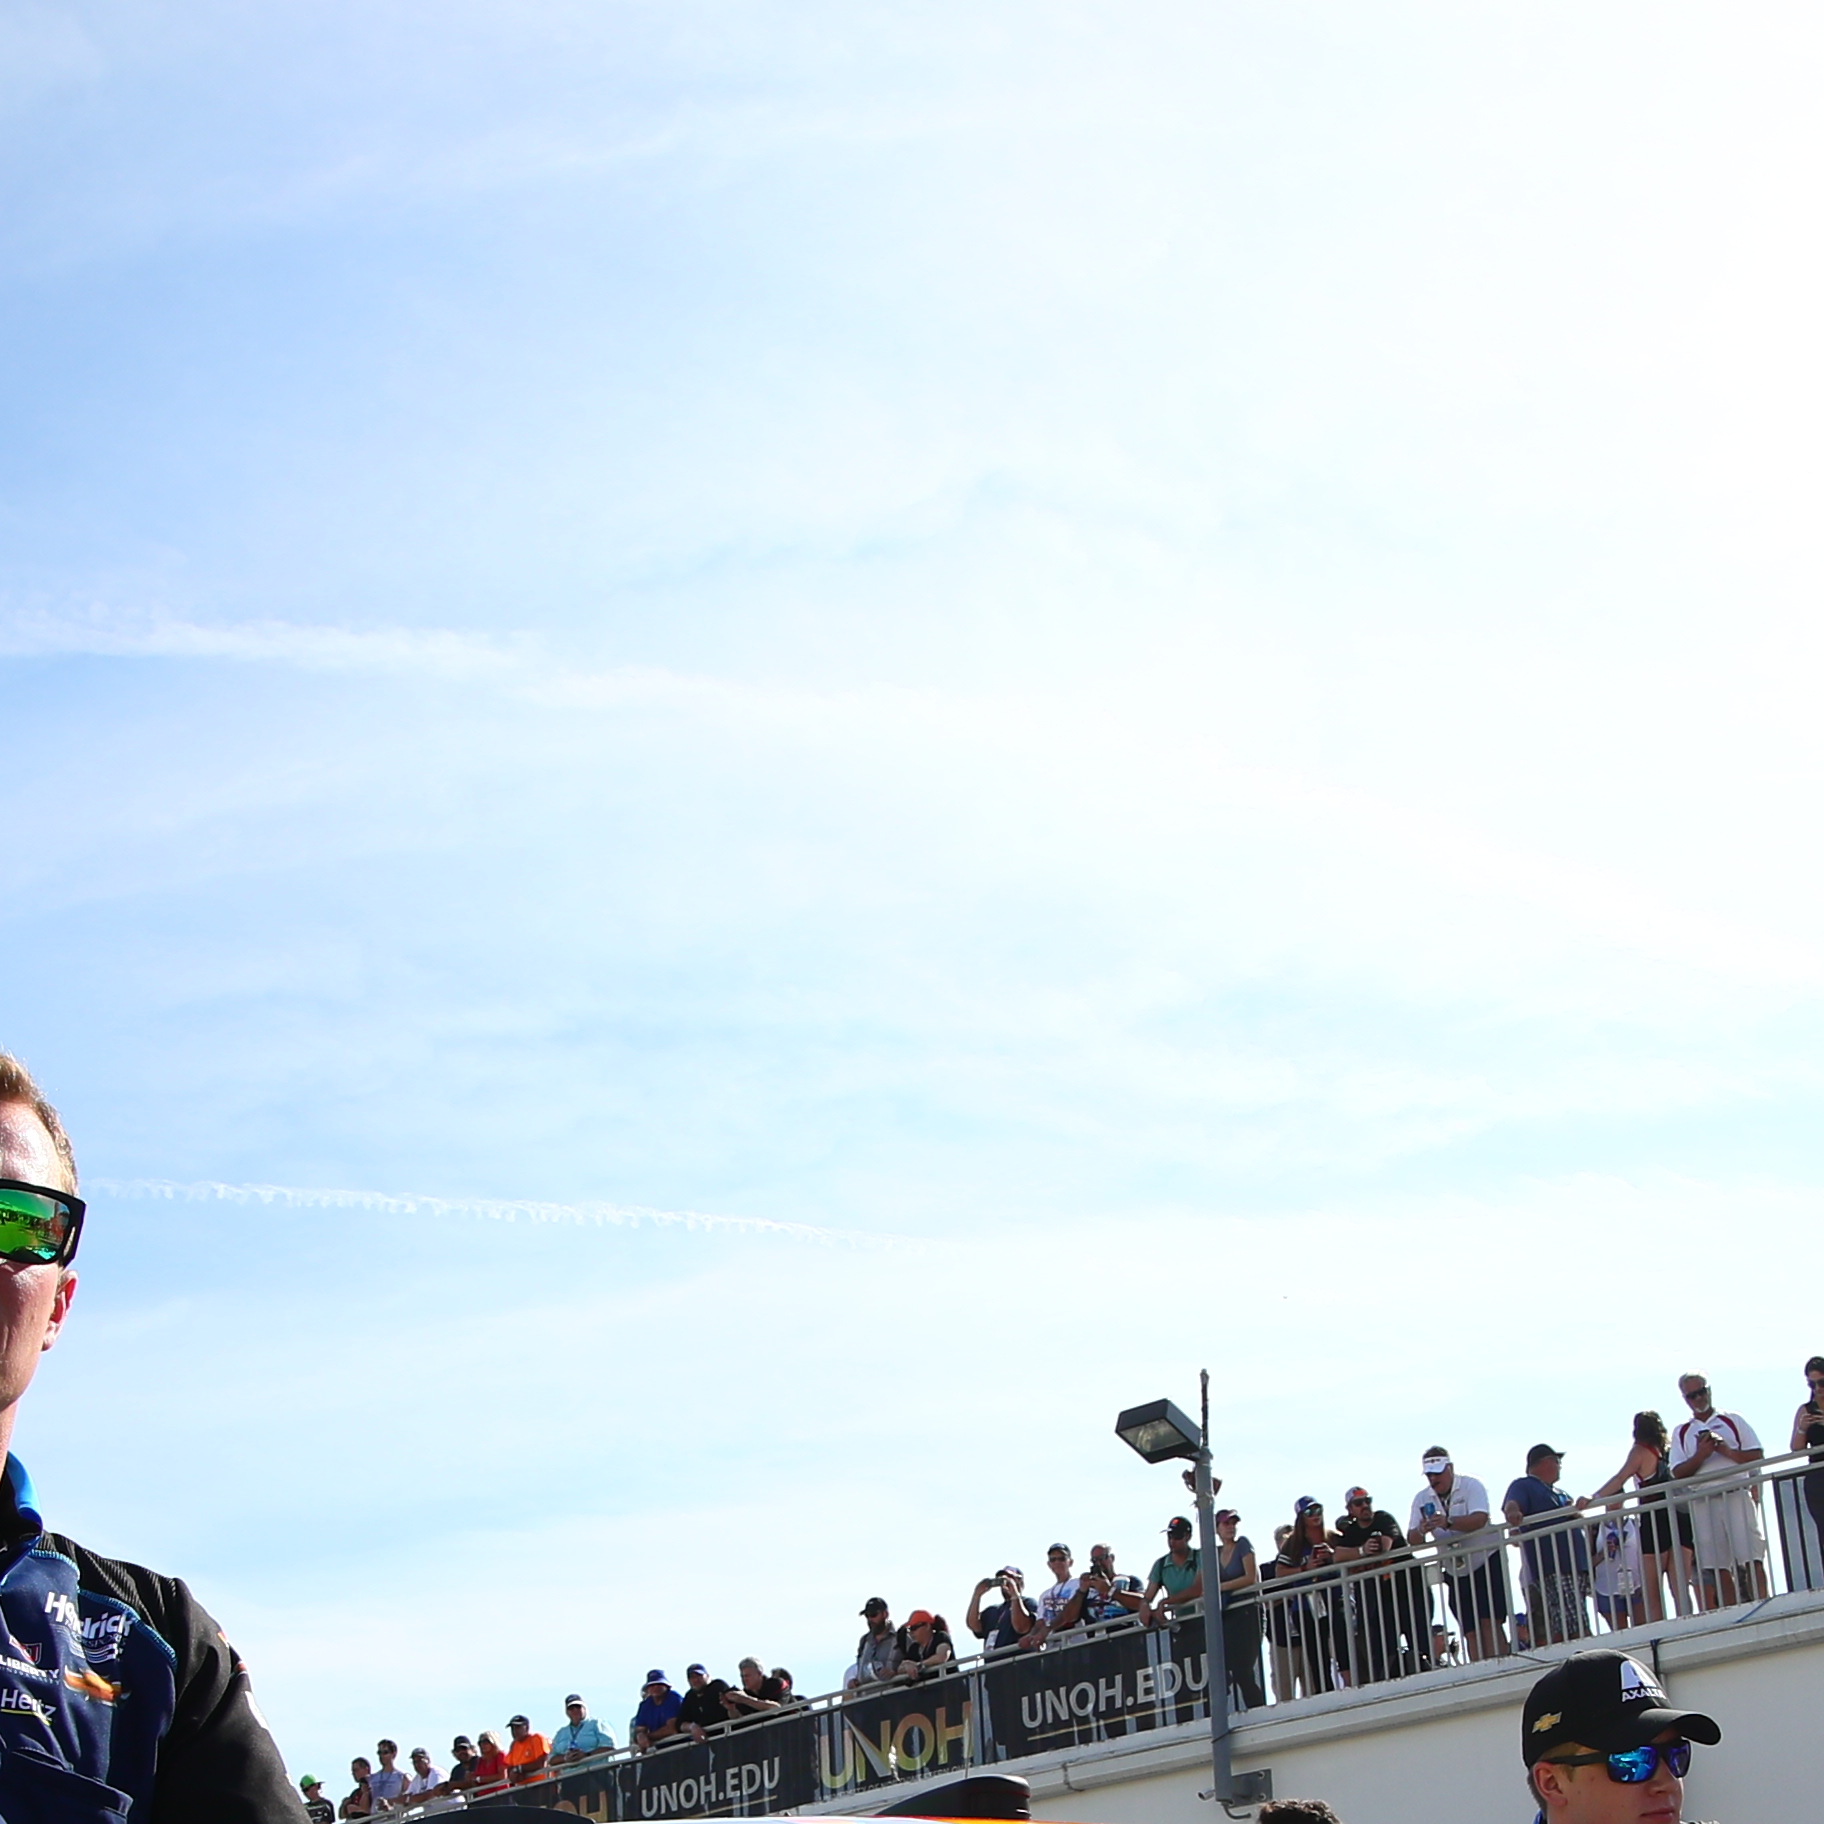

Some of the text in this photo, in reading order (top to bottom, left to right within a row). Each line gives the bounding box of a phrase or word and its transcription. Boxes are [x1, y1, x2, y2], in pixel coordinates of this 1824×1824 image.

[44, 1591, 133, 1639] Hedrick
[0, 1687, 57, 1721] Hertz
[1021, 1653, 1210, 1729] UNOH.EDU
[1621, 1686, 1667, 1704] AXALTA
[819, 1701, 975, 1790] UNOH
[640, 1756, 781, 1818] UNOH.EDU
